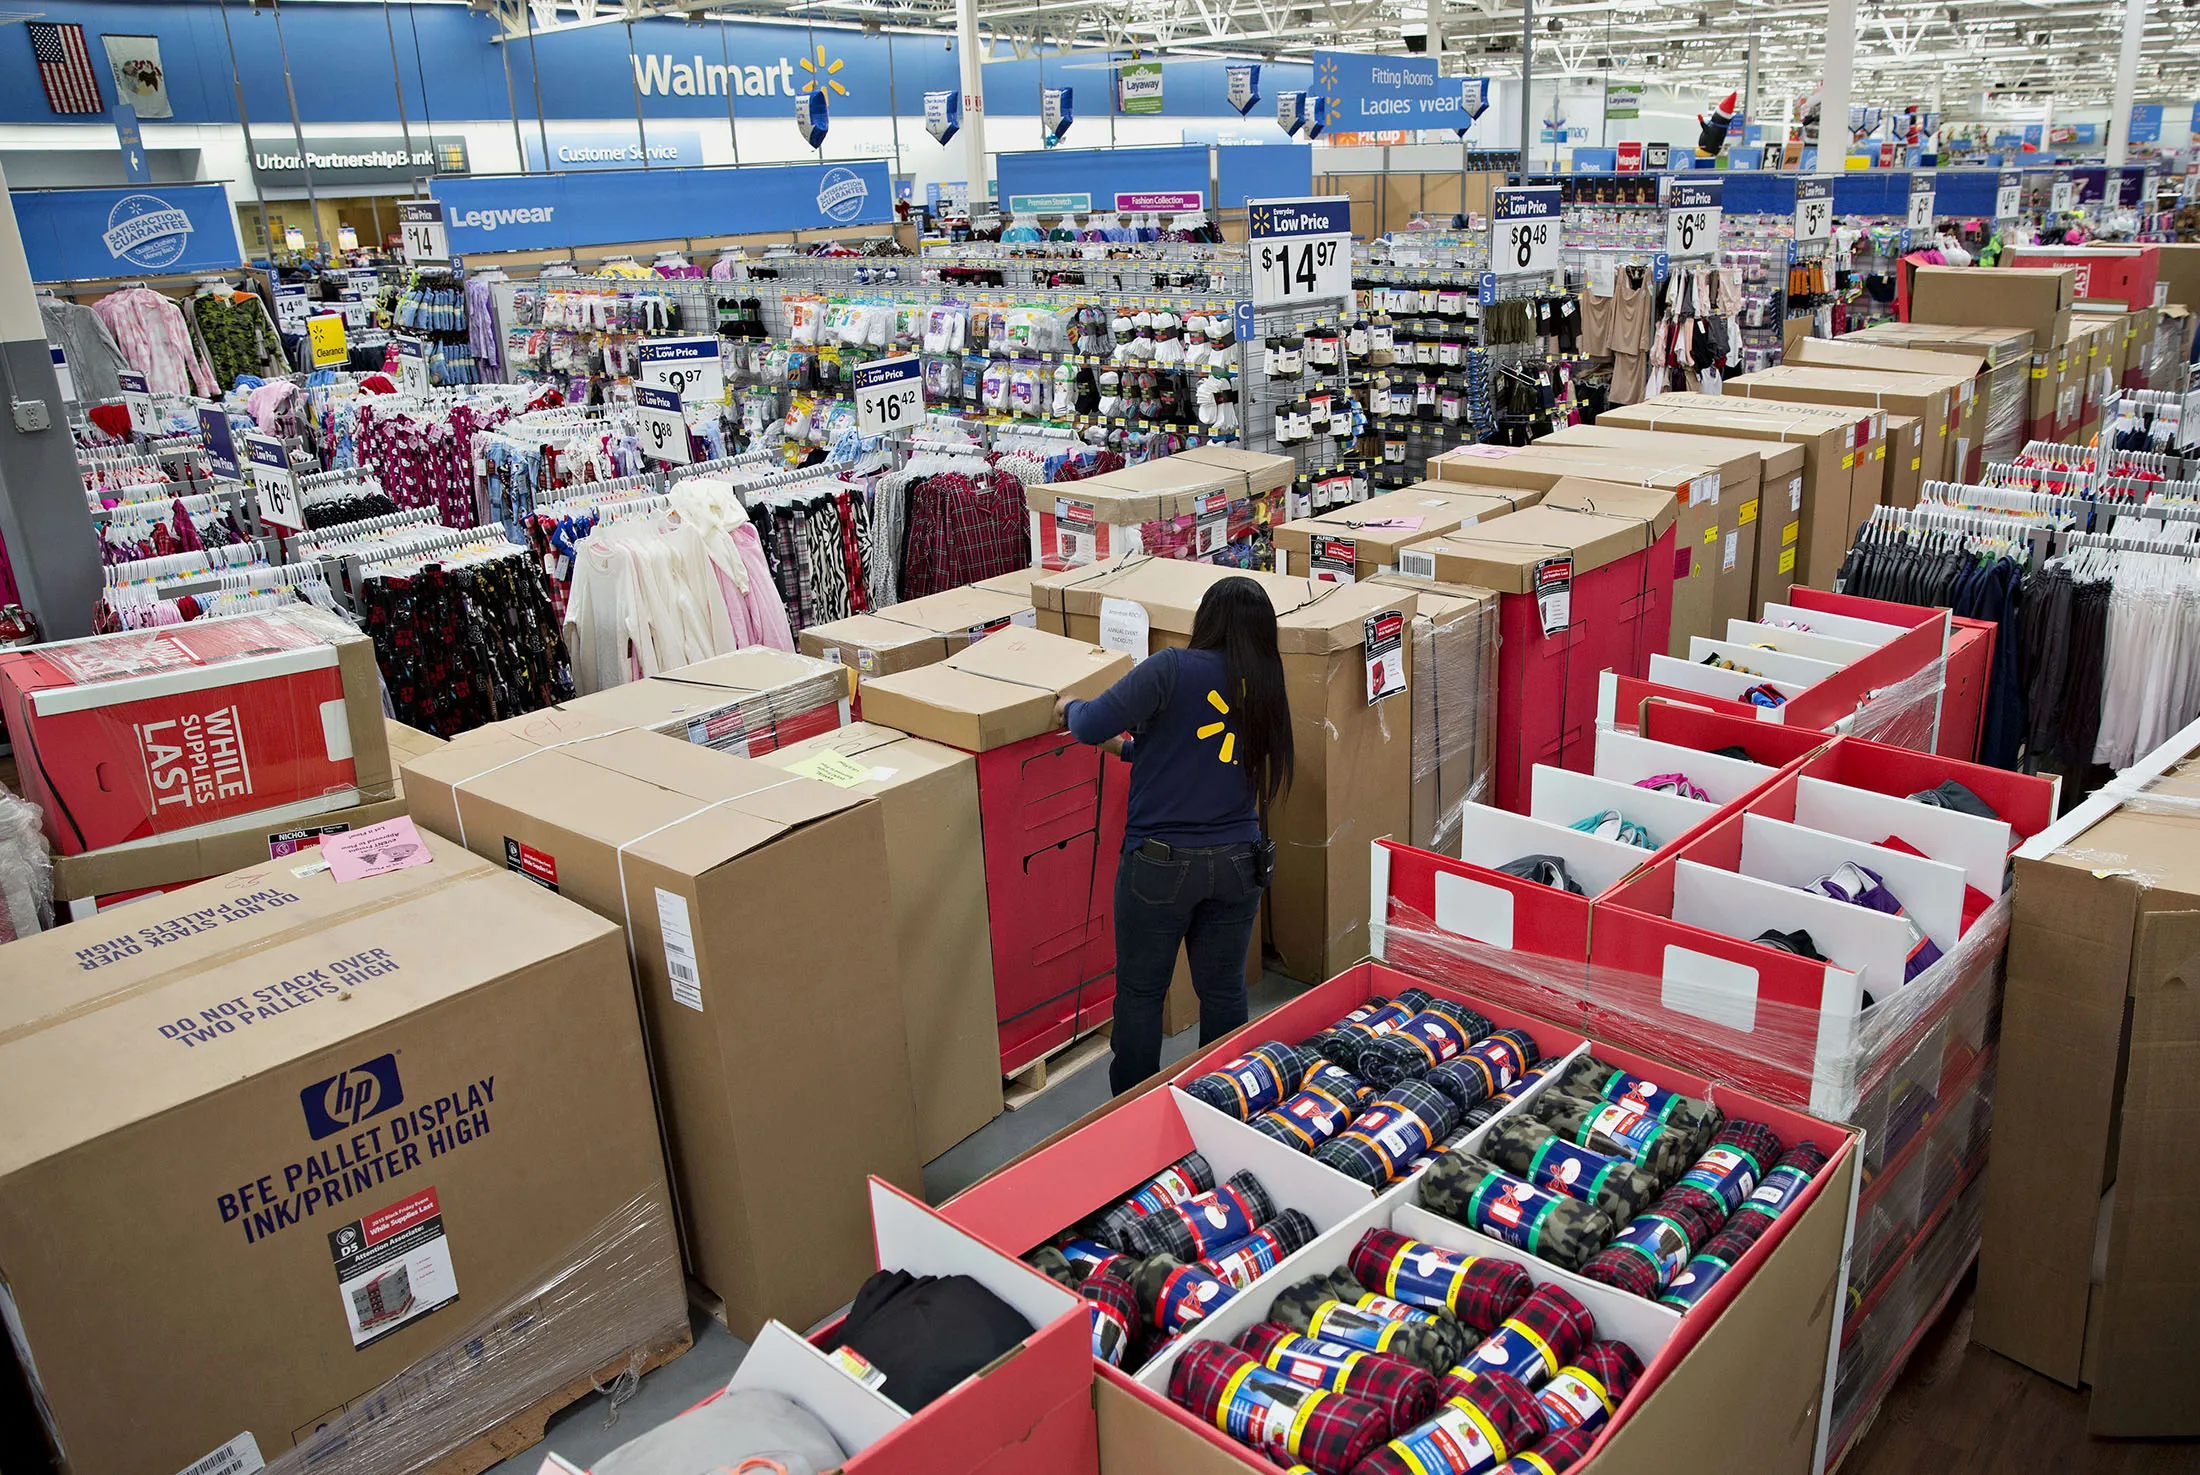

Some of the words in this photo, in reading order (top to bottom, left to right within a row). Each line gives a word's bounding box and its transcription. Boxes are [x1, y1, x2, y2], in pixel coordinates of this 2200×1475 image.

[629, 54, 796, 97] Walmart
[1372, 67, 1401, 88] Fitting
[1403, 69, 1434, 86] Rooms
[1127, 79, 1160, 93] Layaway
[1609, 96, 1638, 105] Layaway
[558, 145, 627, 163] Customer
[629, 144, 678, 160] Service
[820, 180, 861, 202] SATISFACTION
[821, 187, 865, 209] GUARANTEE
[1682, 193, 1694, 204] Low
[1695, 193, 1711, 204] Price
[1027, 198, 1052, 206] Premium
[1052, 198, 1072, 206] Stretch
[1131, 196, 1153, 205] Fashion
[1154, 196, 1184, 204] Collection
[1510, 201, 1527, 215] Low
[1528, 200, 1547, 214] Price
[408, 211, 419, 221] Low
[419, 210, 432, 220] Price
[450, 206, 555, 231] Legwear
[1274, 216, 1299, 232] Low
[1301, 213, 1329, 231] Price
[108, 213, 183, 243] SATISFACTION
[113, 221, 188, 251] GUARANTEE
[154, 238, 177, 250] Clothing
[408, 227, 432, 256] $14
[454, 258, 461, 268] B
[1657, 255, 1665, 266] C
[272, 270, 278, 280] B
[453, 270, 463, 279] 27
[1483, 274, 1492, 287] C
[1657, 270, 1664, 279] 5
[272, 282, 281, 291] 29
[1483, 292, 1491, 302] 3
[1239, 304, 1250, 319] C
[1240, 325, 1247, 337] 1
[316, 347, 345, 358] Clearance
[656, 350, 674, 358] Low
[676, 348, 698, 358] Price
[869, 374, 884, 383] Low
[885, 370, 904, 380] Price
[645, 395, 656, 404] Low
[656, 397, 671, 408] Price
[1791, 405, 1848, 420] REMOVE
[211, 456, 221, 468] Low
[221, 460, 235, 472] Price
[256, 448, 265, 459] Low
[265, 451, 278, 464] Price
[181, 714, 216, 804] SUPPLIES
[204, 707, 245, 799] WHILE
[142, 720, 193, 808] LAST
[278, 831, 308, 841] NICHOL
[74, 934, 136, 961] HIGH
[137, 903, 234, 939] PALLETS
[234, 888, 286, 907] TWO
[77, 943, 143, 972] OVER
[144, 918, 219, 949] STACK
[225, 904, 265, 924] NOT
[267, 892, 301, 908] DO
[157, 1017, 197, 1040] DO
[199, 997, 250, 1023] NOT
[252, 969, 330, 1003] STACK
[328, 948, 392, 974] OVER
[176, 1019, 236, 1048] TWO
[237, 981, 340, 1026] PALLETS
[339, 959, 400, 986] HIGH
[334, 1071, 373, 1126] hp
[217, 1175, 278, 1224] BFE
[283, 1126, 382, 1193] PALLET
[390, 1075, 495, 1145] DISPLAY
[241, 1142, 422, 1244] INK/PRINTER
[427, 1109, 490, 1159] HIGH
[369, 1223, 390, 1237] While
[390, 1210, 418, 1228] Supplies
[419, 1202, 434, 1214] Last
[341, 1242, 359, 1258] D5
[355, 1240, 389, 1262] Attention
[389, 1225, 425, 1247] Associate:
